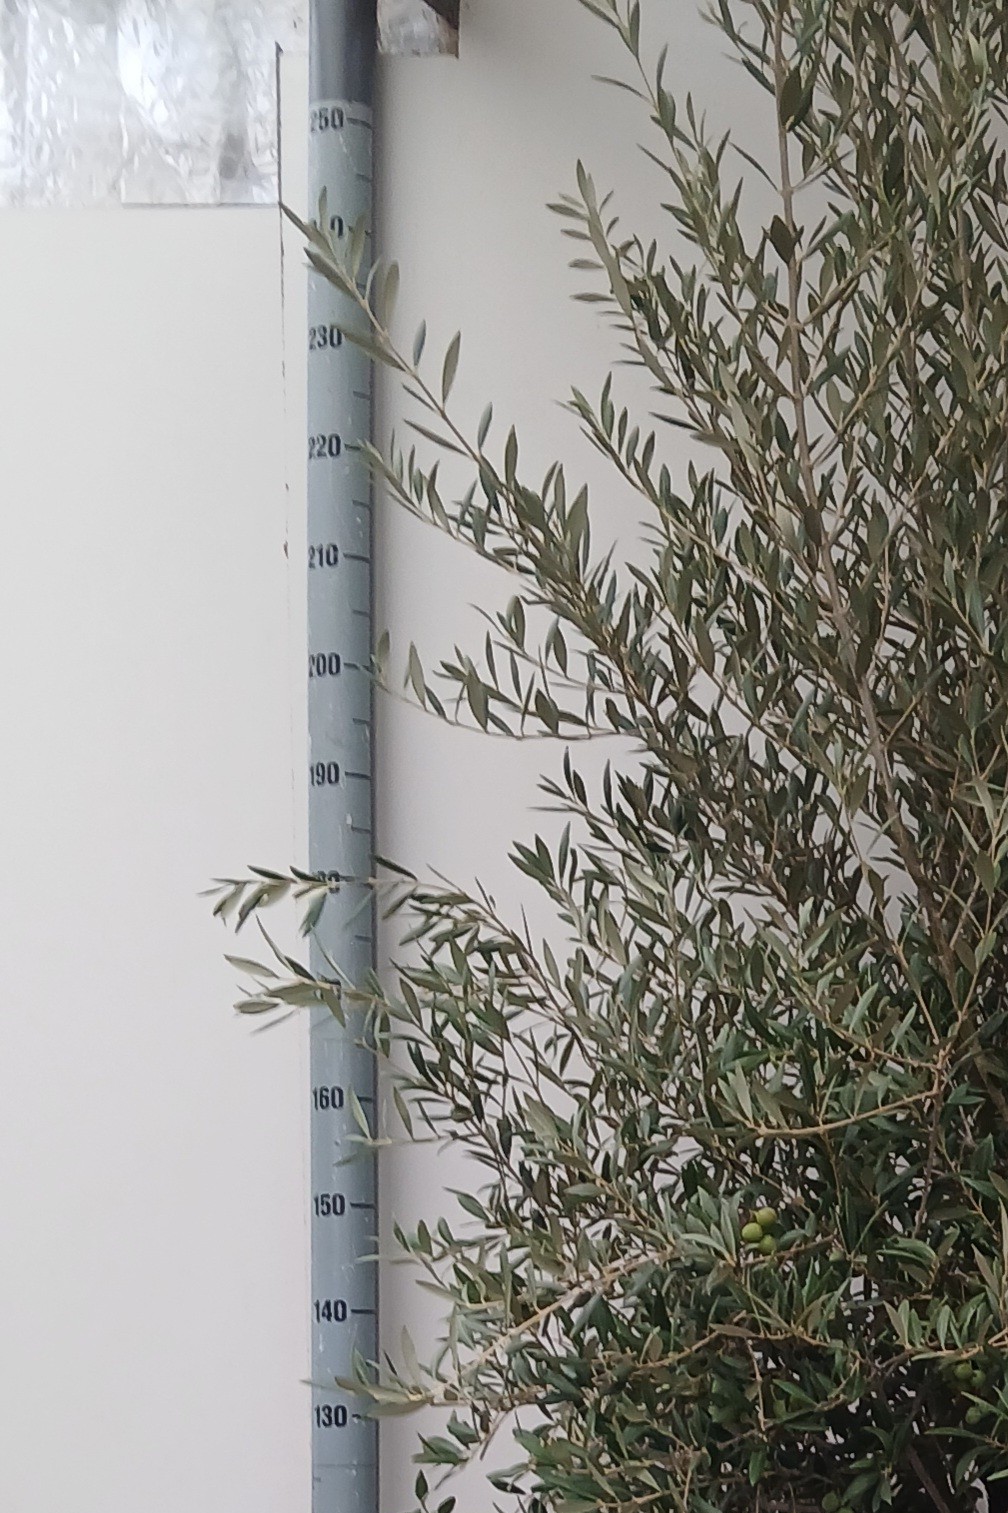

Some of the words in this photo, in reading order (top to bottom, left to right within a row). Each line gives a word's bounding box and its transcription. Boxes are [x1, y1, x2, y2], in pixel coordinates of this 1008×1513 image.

[308, 324, 342, 350] 230
[308, 433, 341, 460] 220
[308, 543, 339, 569] 210
[308, 652, 341, 678] 200
[310, 761, 340, 786] 190
[312, 1085, 344, 1110] 160
[314, 1193, 346, 1217] 150
[314, 1299, 347, 1323] 140
[314, 1404, 348, 1428] 130
